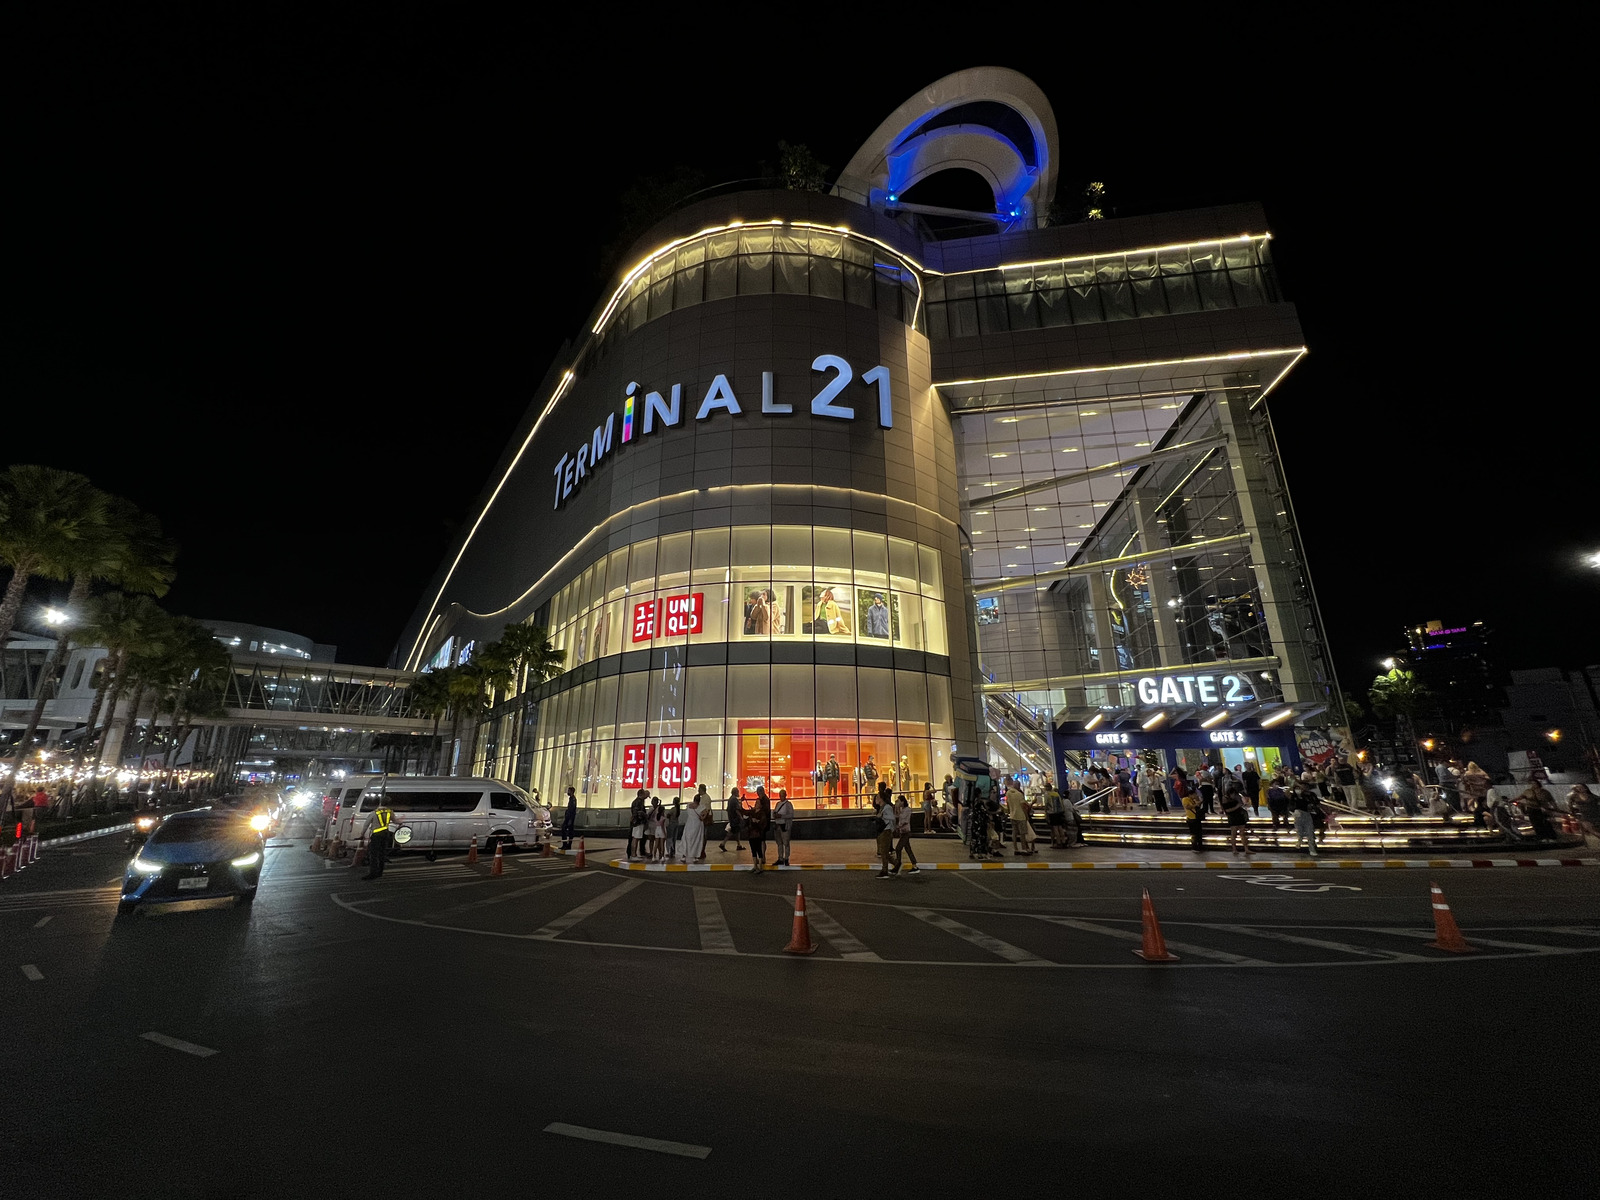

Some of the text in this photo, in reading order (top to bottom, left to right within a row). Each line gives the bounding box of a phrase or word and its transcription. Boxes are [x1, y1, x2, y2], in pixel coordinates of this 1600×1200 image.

[811, 354, 892, 428] 21
[669, 597, 696, 614] UNI
[668, 614, 698, 633] QLO
[1138, 675, 1244, 704] GATE 2
[1095, 733, 1129, 744] GATE 2
[1210, 731, 1244, 742] GATE 2
[662, 747, 690, 764] UNI
[661, 766, 692, 785] QLO
